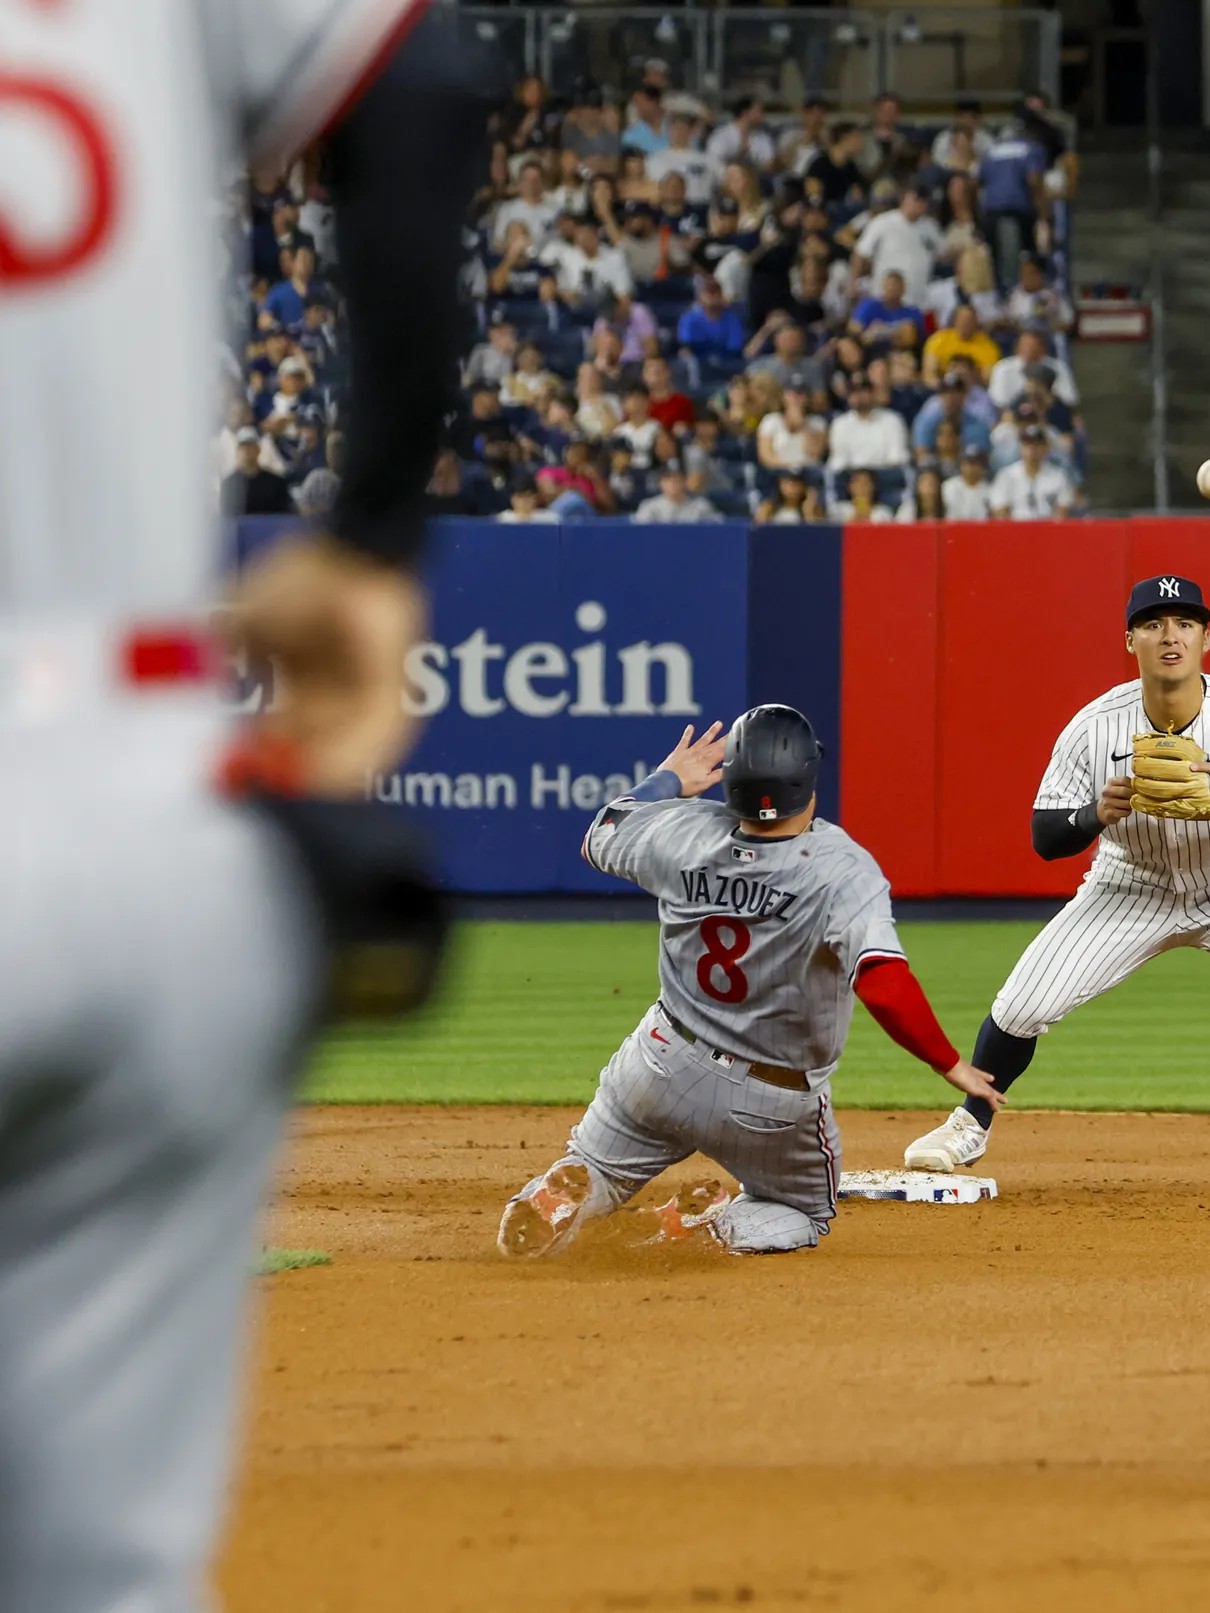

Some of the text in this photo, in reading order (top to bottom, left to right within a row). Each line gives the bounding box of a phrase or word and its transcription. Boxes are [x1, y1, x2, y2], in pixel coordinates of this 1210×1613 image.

[364, 764, 517, 809] uman
[761, 796, 772, 809] 8
[680, 866, 798, 922] VÁZQUEZ
[696, 914, 751, 1004] 8
